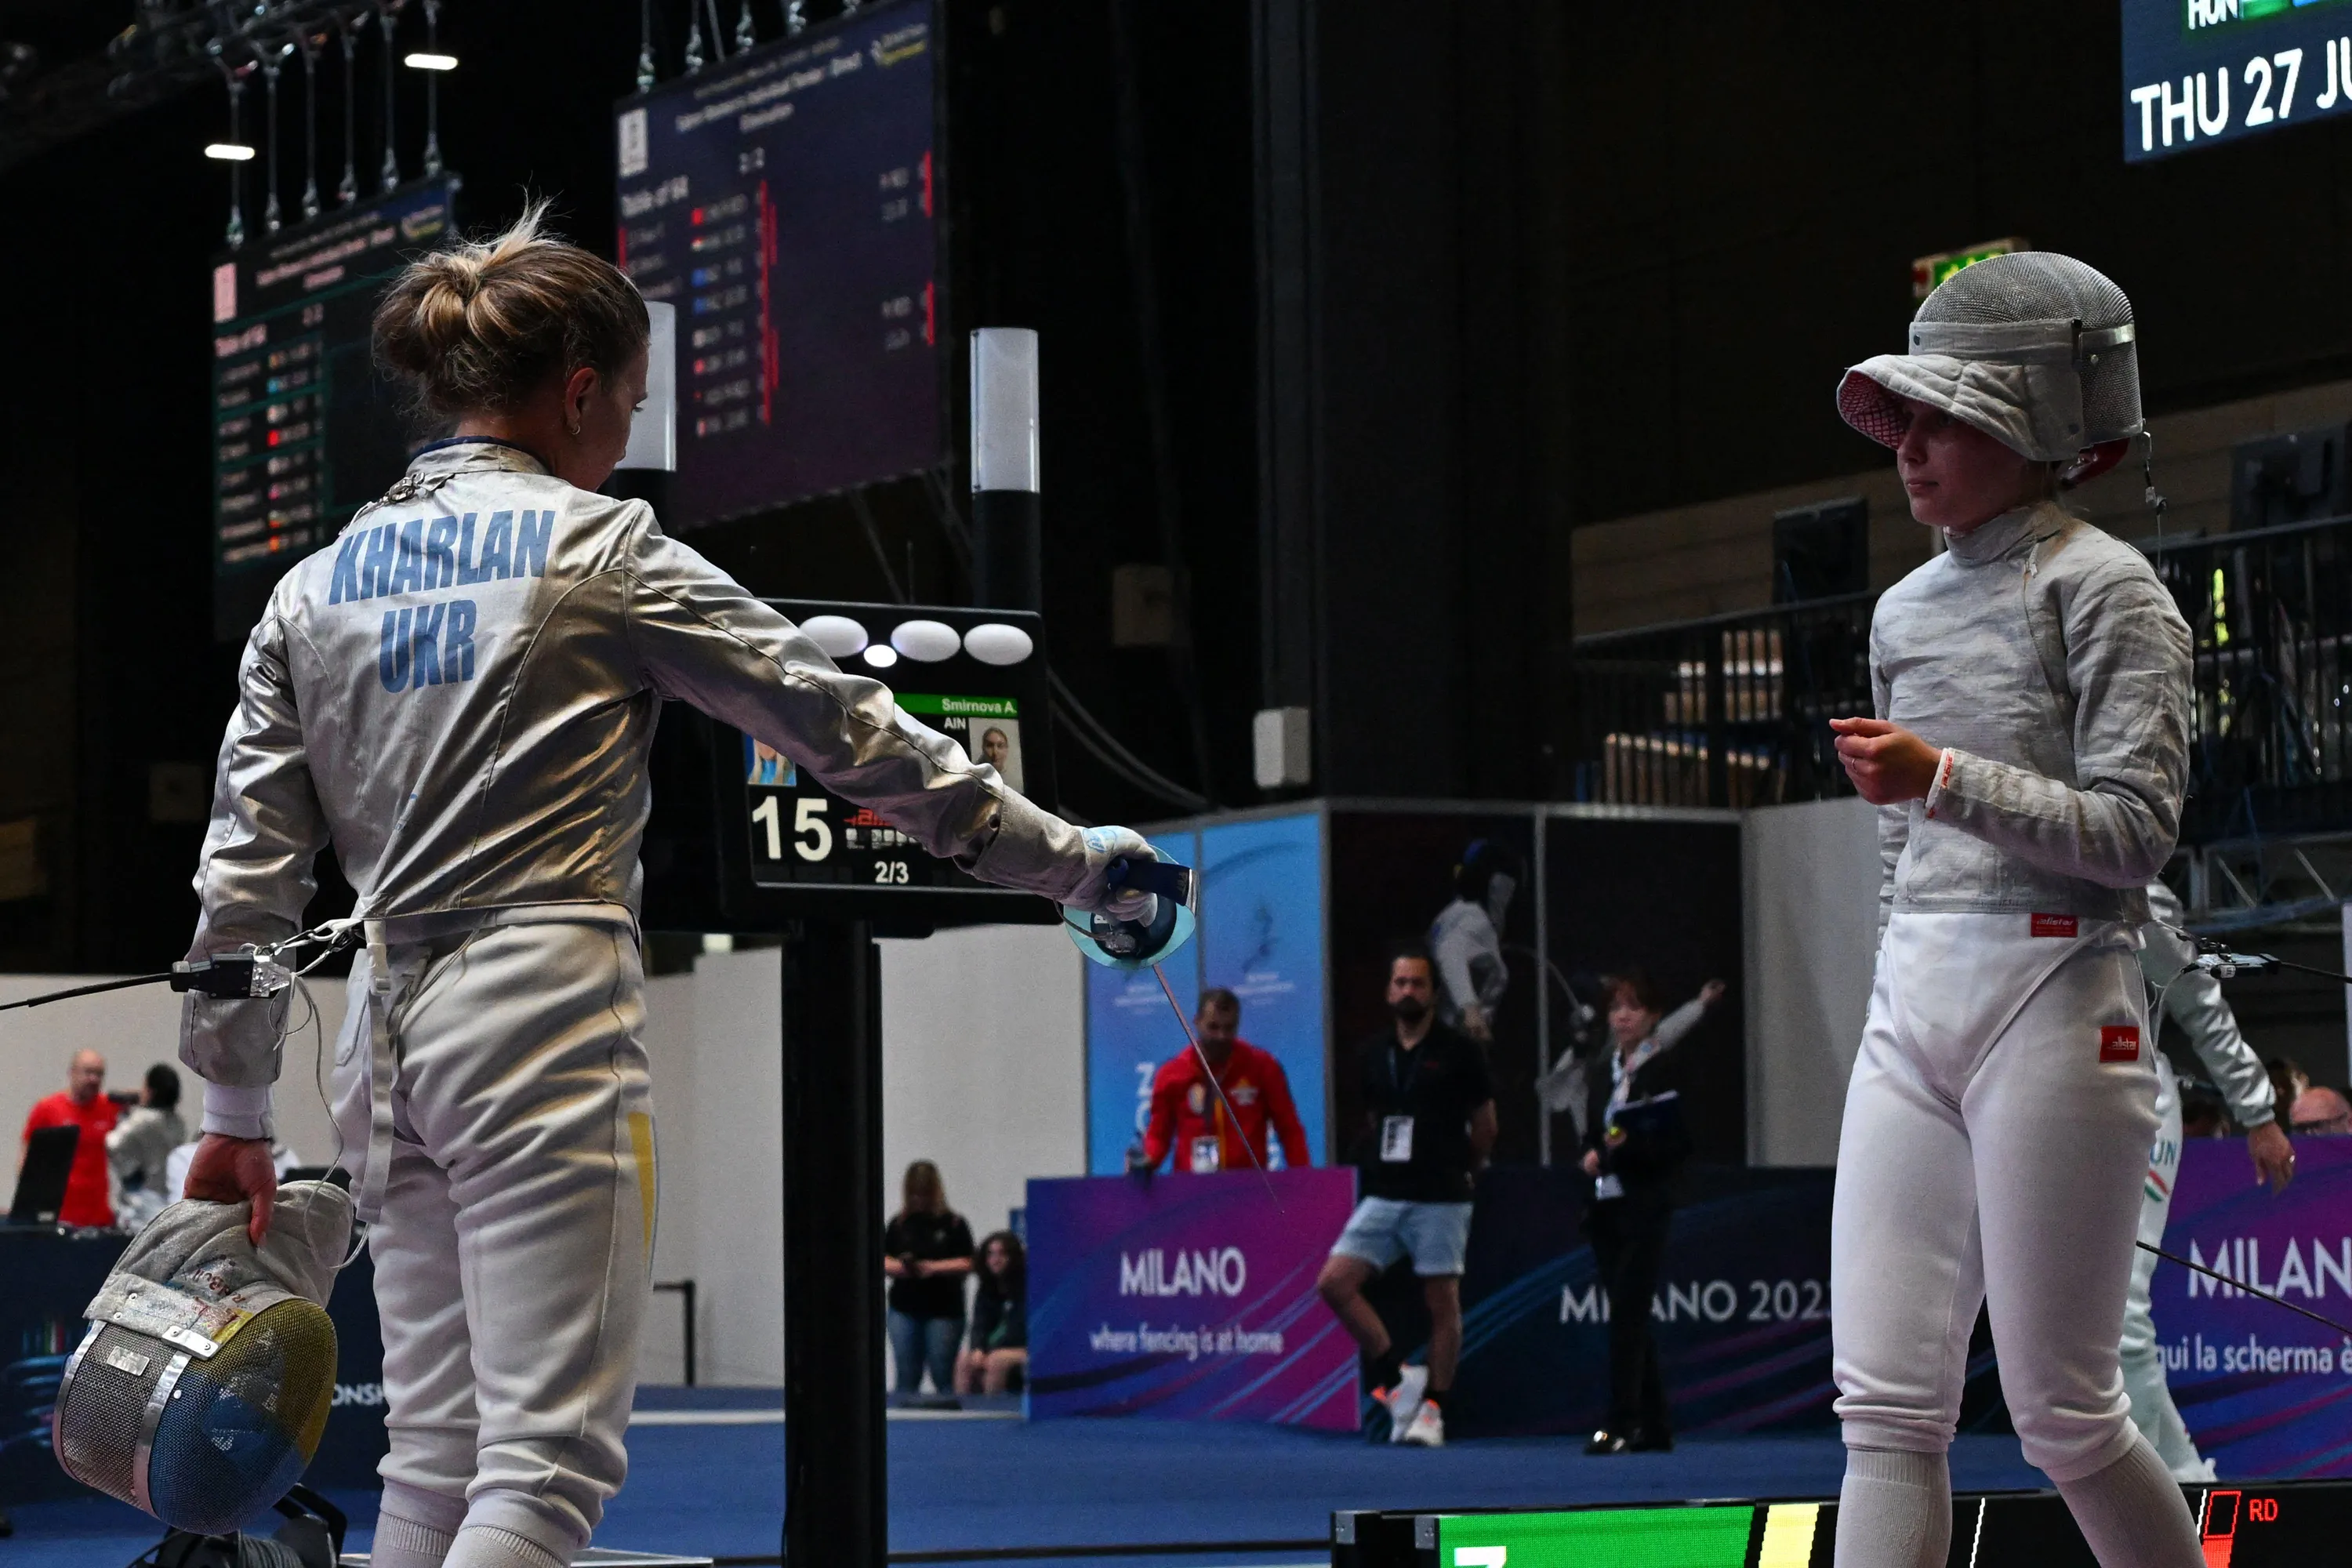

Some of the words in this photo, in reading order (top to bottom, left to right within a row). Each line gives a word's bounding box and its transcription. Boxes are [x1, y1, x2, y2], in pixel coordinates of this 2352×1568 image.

[2130, 67, 2229, 151] THU
[2244, 48, 2303, 127] 27
[328, 510, 556, 605] KHARLAN
[379, 599, 477, 694] UKR
[942, 697, 1002, 713] Smirnova
[944, 717, 966, 730] AIN
[752, 795, 833, 862] 15
[874, 861, 909, 884] 2/3
[1120, 1246, 1247, 1297] MILANO
[1747, 1279, 1831, 1323] 202
[2196, 1332, 2217, 1370] la
[2223, 1333, 2333, 1374] scherma
[2249, 1499, 2278, 1522] RD
